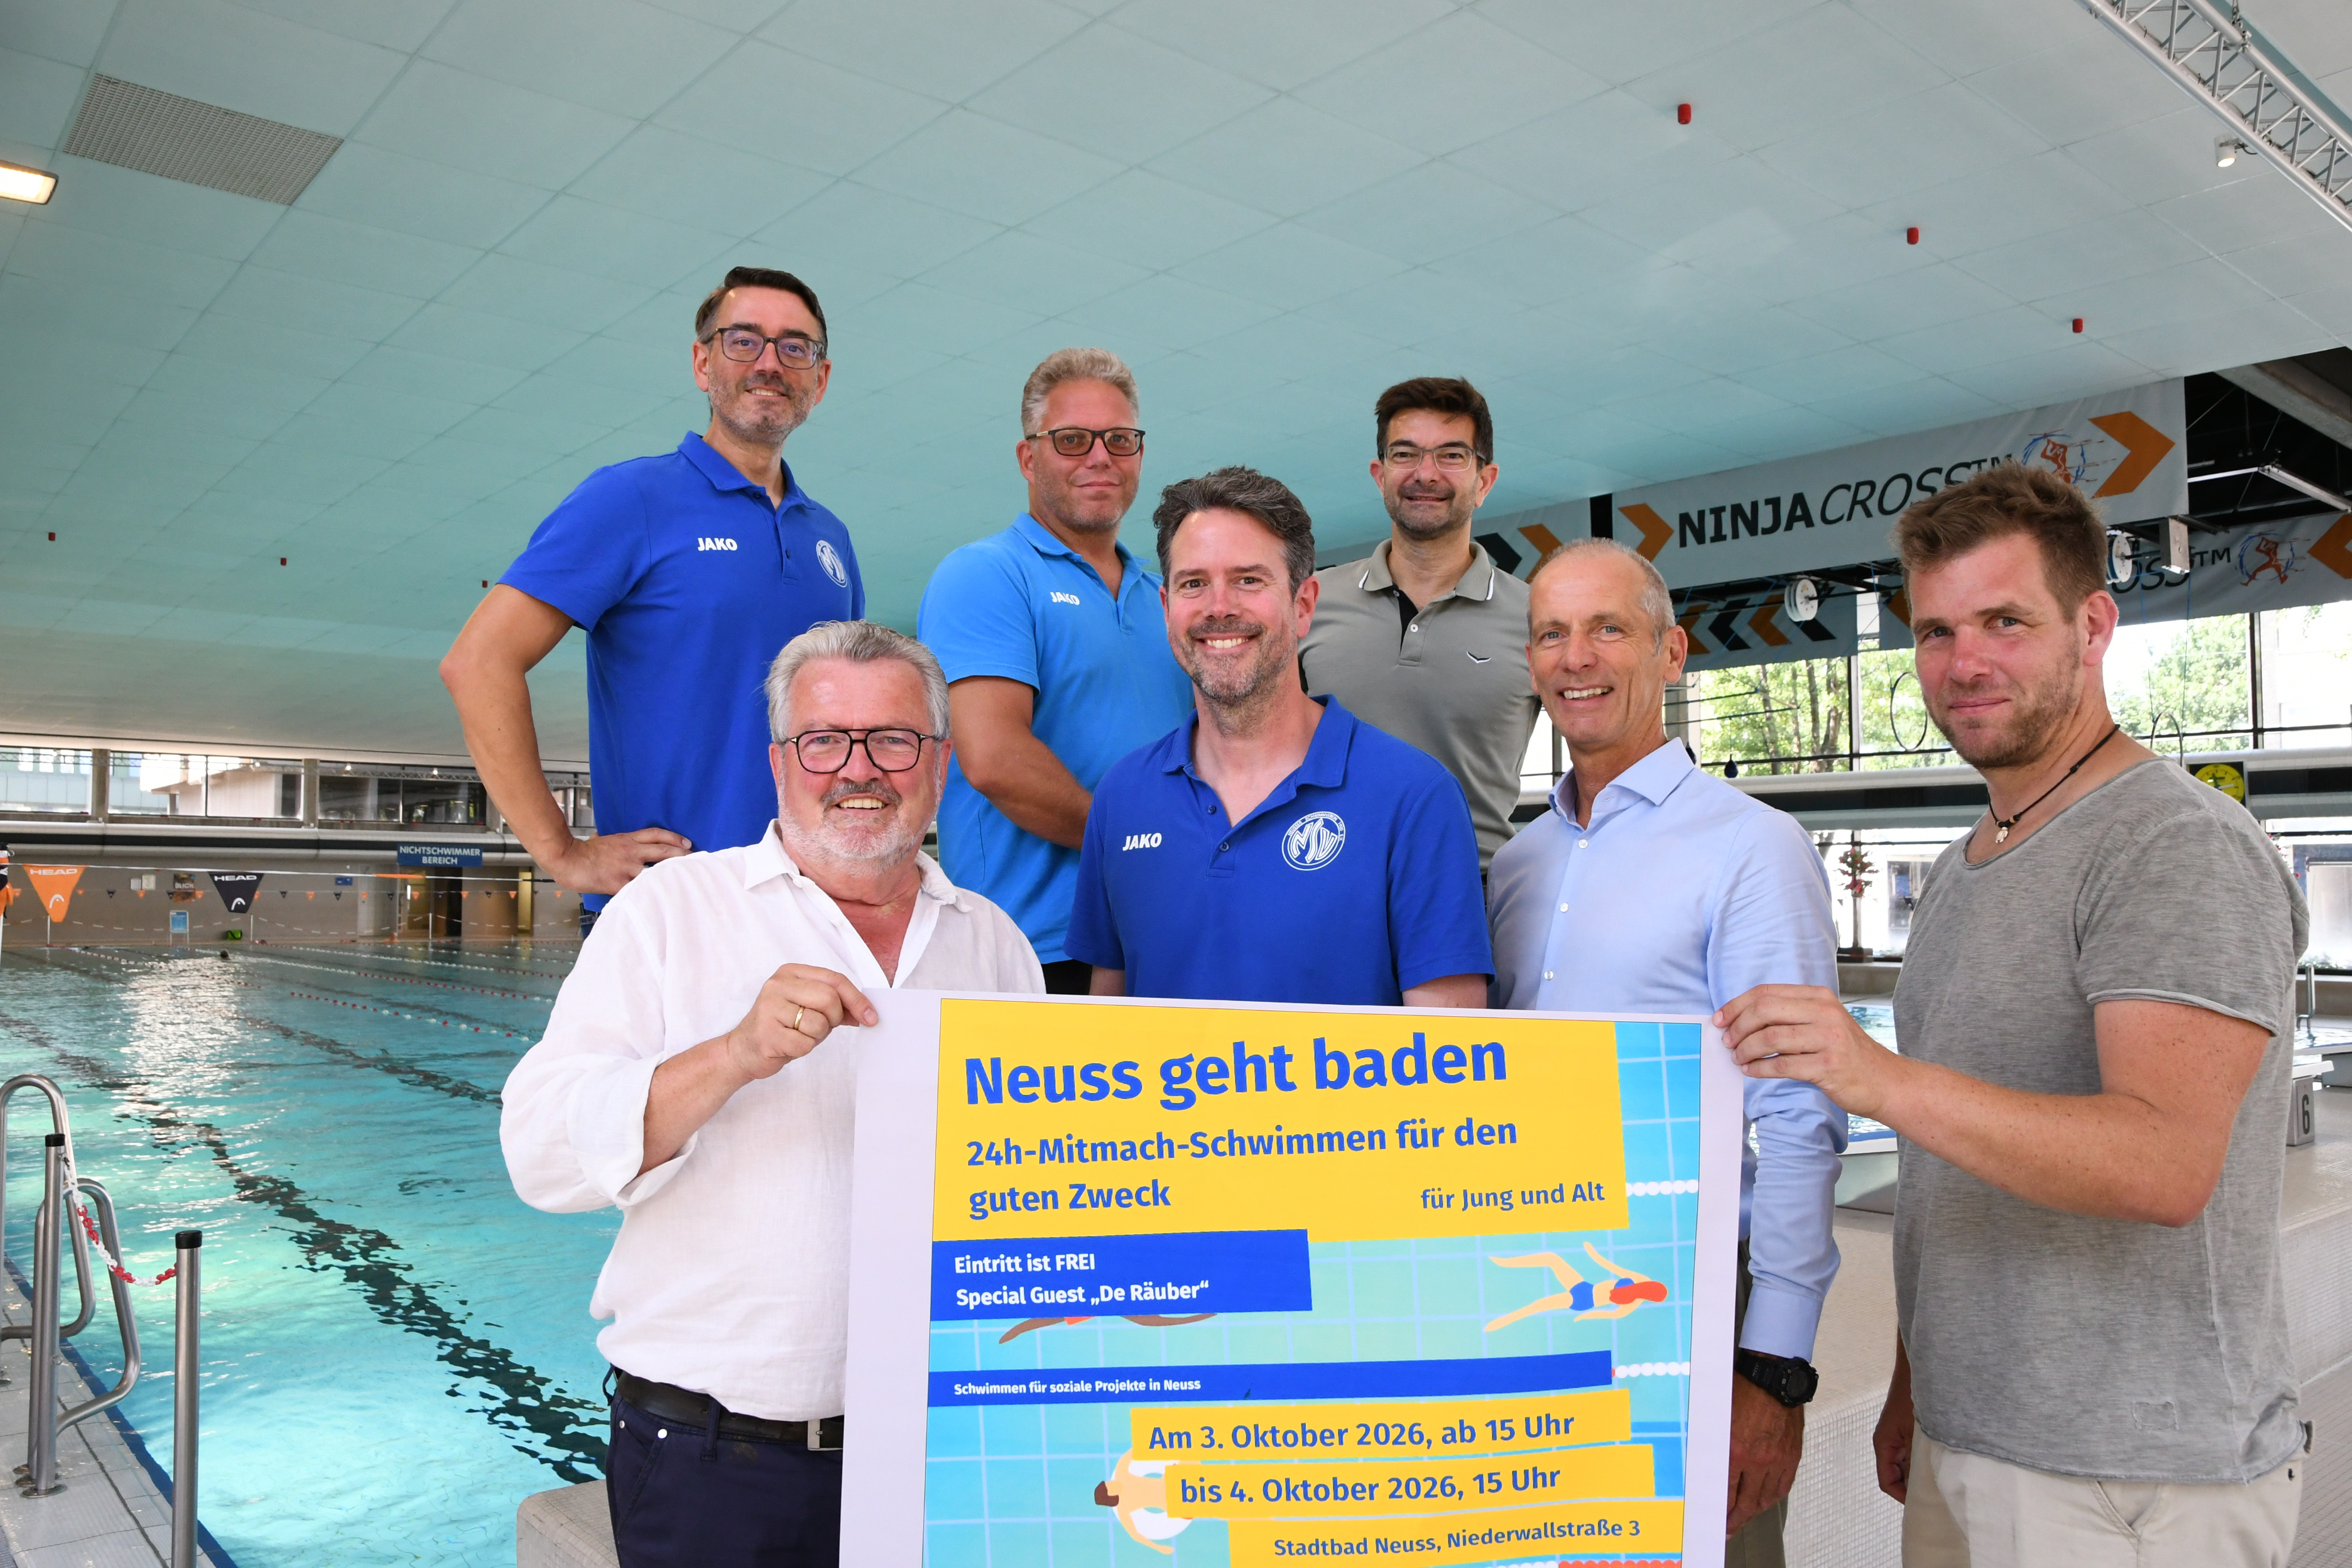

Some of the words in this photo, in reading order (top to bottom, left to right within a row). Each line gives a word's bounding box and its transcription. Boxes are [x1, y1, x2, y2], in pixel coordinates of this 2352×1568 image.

[698, 537, 738, 551] JAKO
[1050, 591, 1080, 605] JAKO
[399, 846, 480, 856] NICHTSCHWIMMER
[1122, 833, 1162, 851] JAKO
[422, 856, 458, 865] BEREICH
[966, 1057, 1143, 1104] Neuss
[1160, 1041, 1298, 1111] geht
[1313, 1032, 1507, 1090] baden
[2302, 1094, 2310, 1134] 6
[968, 1125, 1386, 1166] 24h-Mitmach-Schwimmen
[1396, 1118, 1445, 1149] für
[1455, 1117, 1517, 1146] den
[970, 1188, 1059, 1220] guten
[1069, 1179, 1171, 1209] Zweck
[1421, 1188, 1455, 1209] für
[1463, 1190, 1514, 1211] Jung
[1522, 1183, 1565, 1205] und
[1573, 1182, 1605, 1202] Alt
[955, 1254, 1022, 1273] Eintritt
[1027, 1254, 1051, 1271] ist
[1056, 1254, 1094, 1271] FREI
[957, 1286, 1026, 1309] Special
[1031, 1287, 1085, 1303] Guest
[1091, 1286, 1125, 1305] „De
[1131, 1280, 1208, 1300] Räuber“
[955, 1383, 1026, 1395] Schwimmen
[1029, 1381, 1046, 1392] für
[1050, 1380, 1092, 1392] soziale
[1095, 1380, 1146, 1393] Projekte
[1150, 1379, 1160, 1390] in
[1164, 1380, 1200, 1390] Neuss
[1150, 1427, 1192, 1449] Am
[1201, 1426, 1223, 1449] 3.
[1232, 1423, 1348, 1449] Oktober
[1357, 1423, 1432, 1449] 2026,
[1442, 1419, 1476, 1445] ab
[1486, 1419, 1516, 1441] 15
[1525, 1414, 1574, 1438] Uhr
[1181, 1477, 1222, 1503] bis
[1231, 1481, 1254, 1503] 4.
[1263, 1477, 1379, 1502] Oktober
[1388, 1476, 1464, 1500] 2026,
[1473, 1472, 1503, 1494] 15
[1512, 1467, 1560, 1491] Uhr
[1275, 1538, 1368, 1556] Stadtbad
[1376, 1538, 1441, 1553] Neuss,
[1448, 1519, 1623, 1548] Niederwallstraße
[1631, 1521, 1640, 1536] 3
